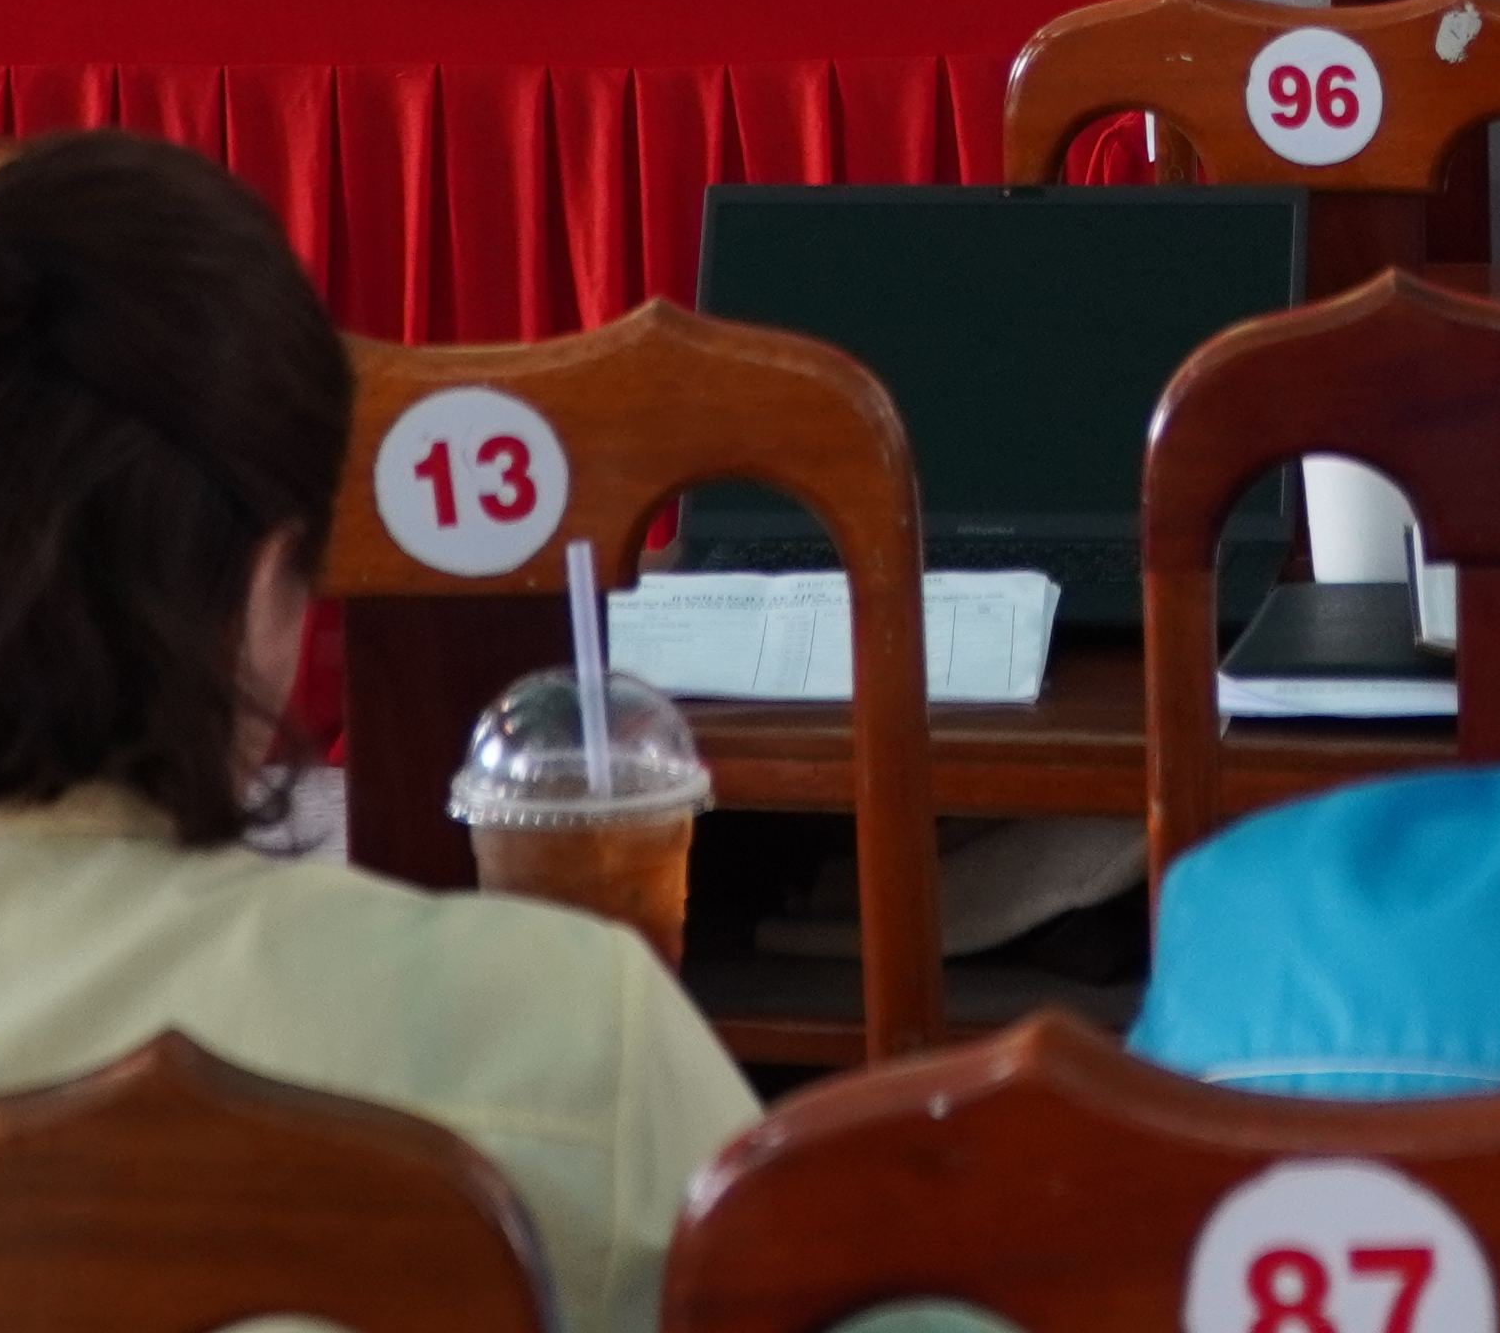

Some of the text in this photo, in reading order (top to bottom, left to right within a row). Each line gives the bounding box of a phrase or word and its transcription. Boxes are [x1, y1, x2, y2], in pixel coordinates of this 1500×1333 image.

[1268, 65, 1359, 129] 96
[414, 435, 537, 527] 13
[1246, 1246, 1436, 1333] 87
